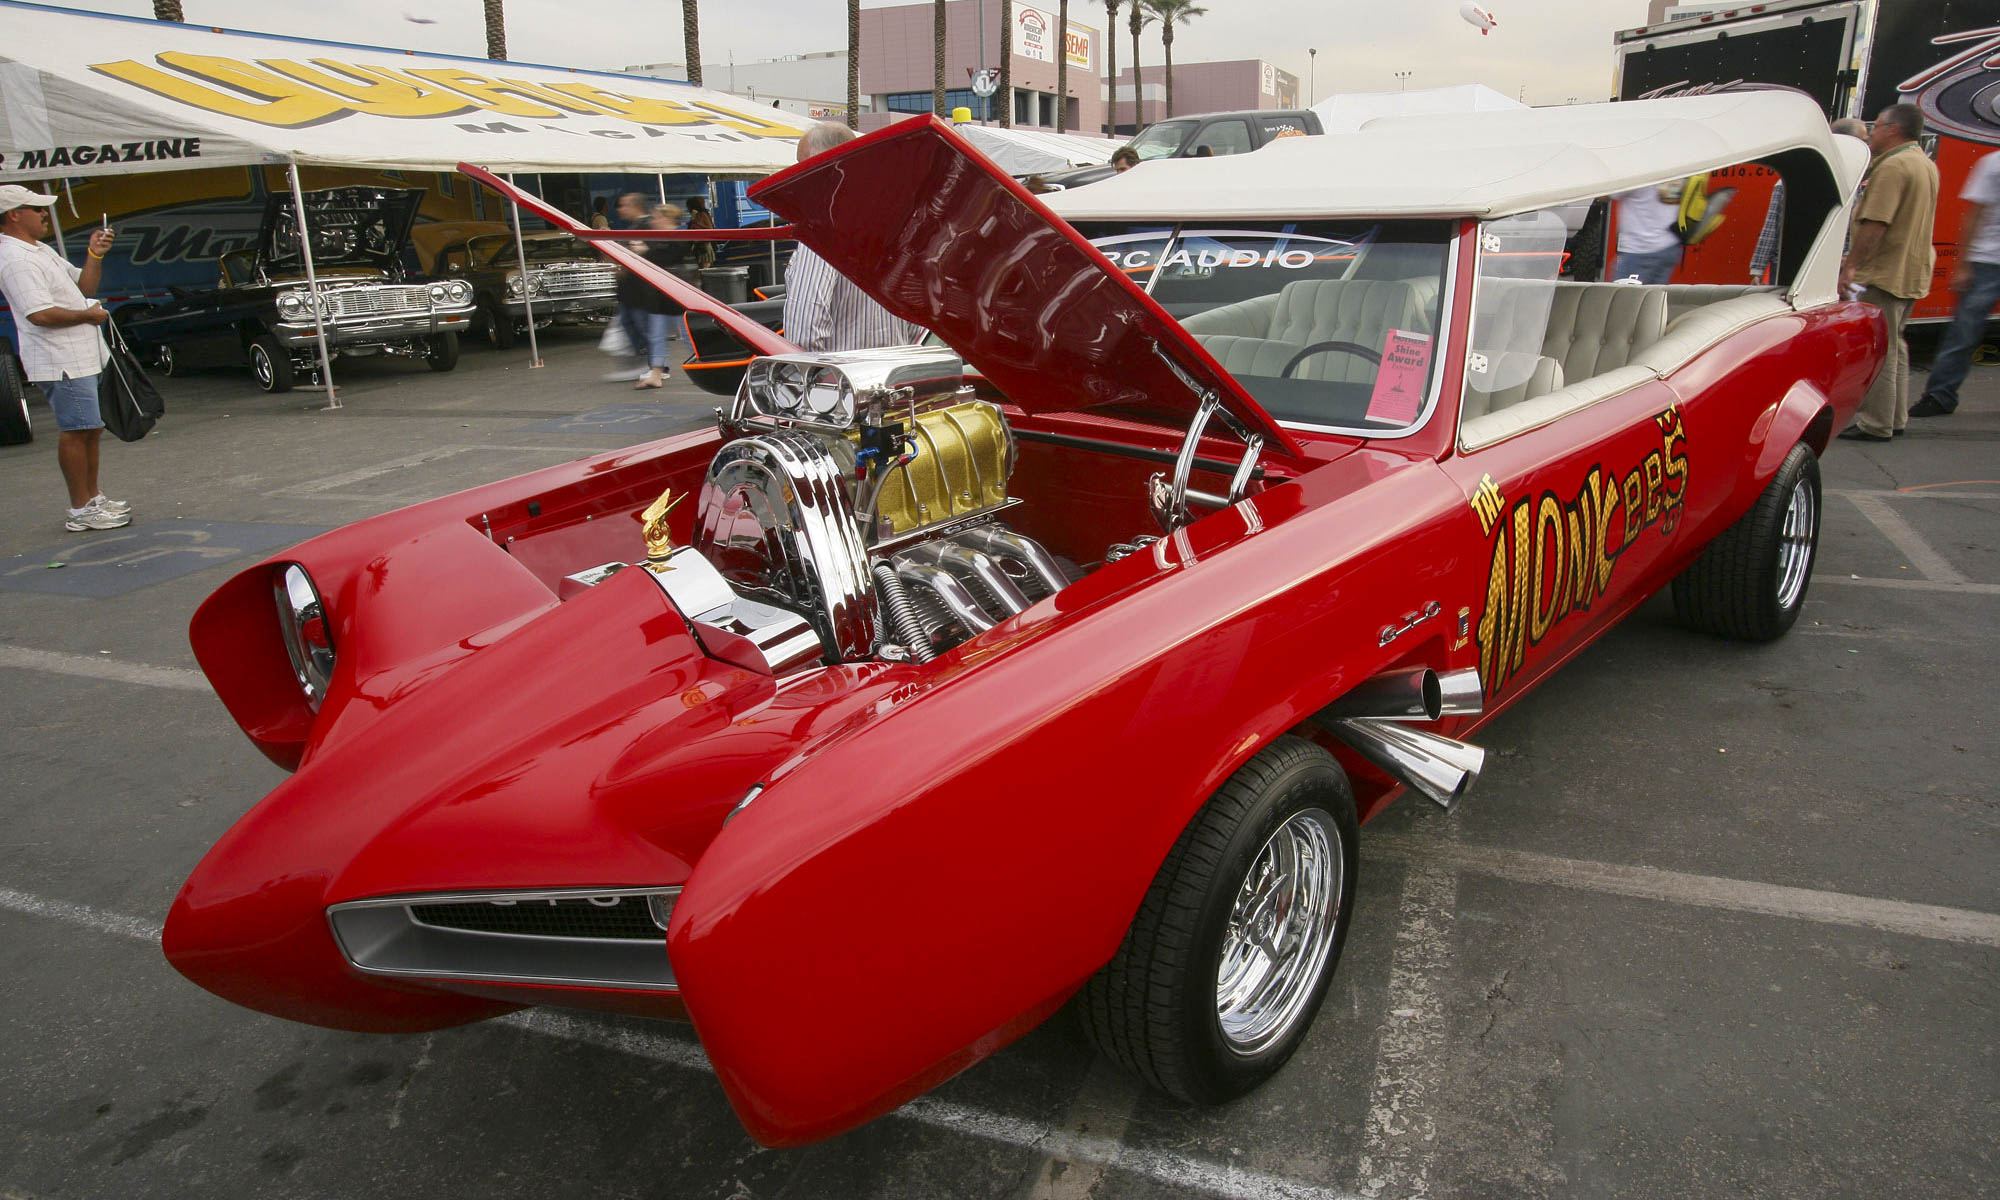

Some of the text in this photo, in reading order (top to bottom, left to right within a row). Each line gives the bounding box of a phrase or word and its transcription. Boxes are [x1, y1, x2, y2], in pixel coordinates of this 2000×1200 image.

[1066, 33, 1088, 57] SEMA
[981, 77, 987, 90] 1
[453, 121, 799, 146] MAGAZI
[18, 137, 201, 170] MAGAZINE
[1101, 249, 1315, 269] RC AUDIO
[1936, 248, 1960, 257] UDIO
[1387, 352, 1425, 367] Award
[1395, 344, 1421, 357] Shine
[1470, 472, 1506, 538] THE
[1377, 600, 1441, 648] GTO
